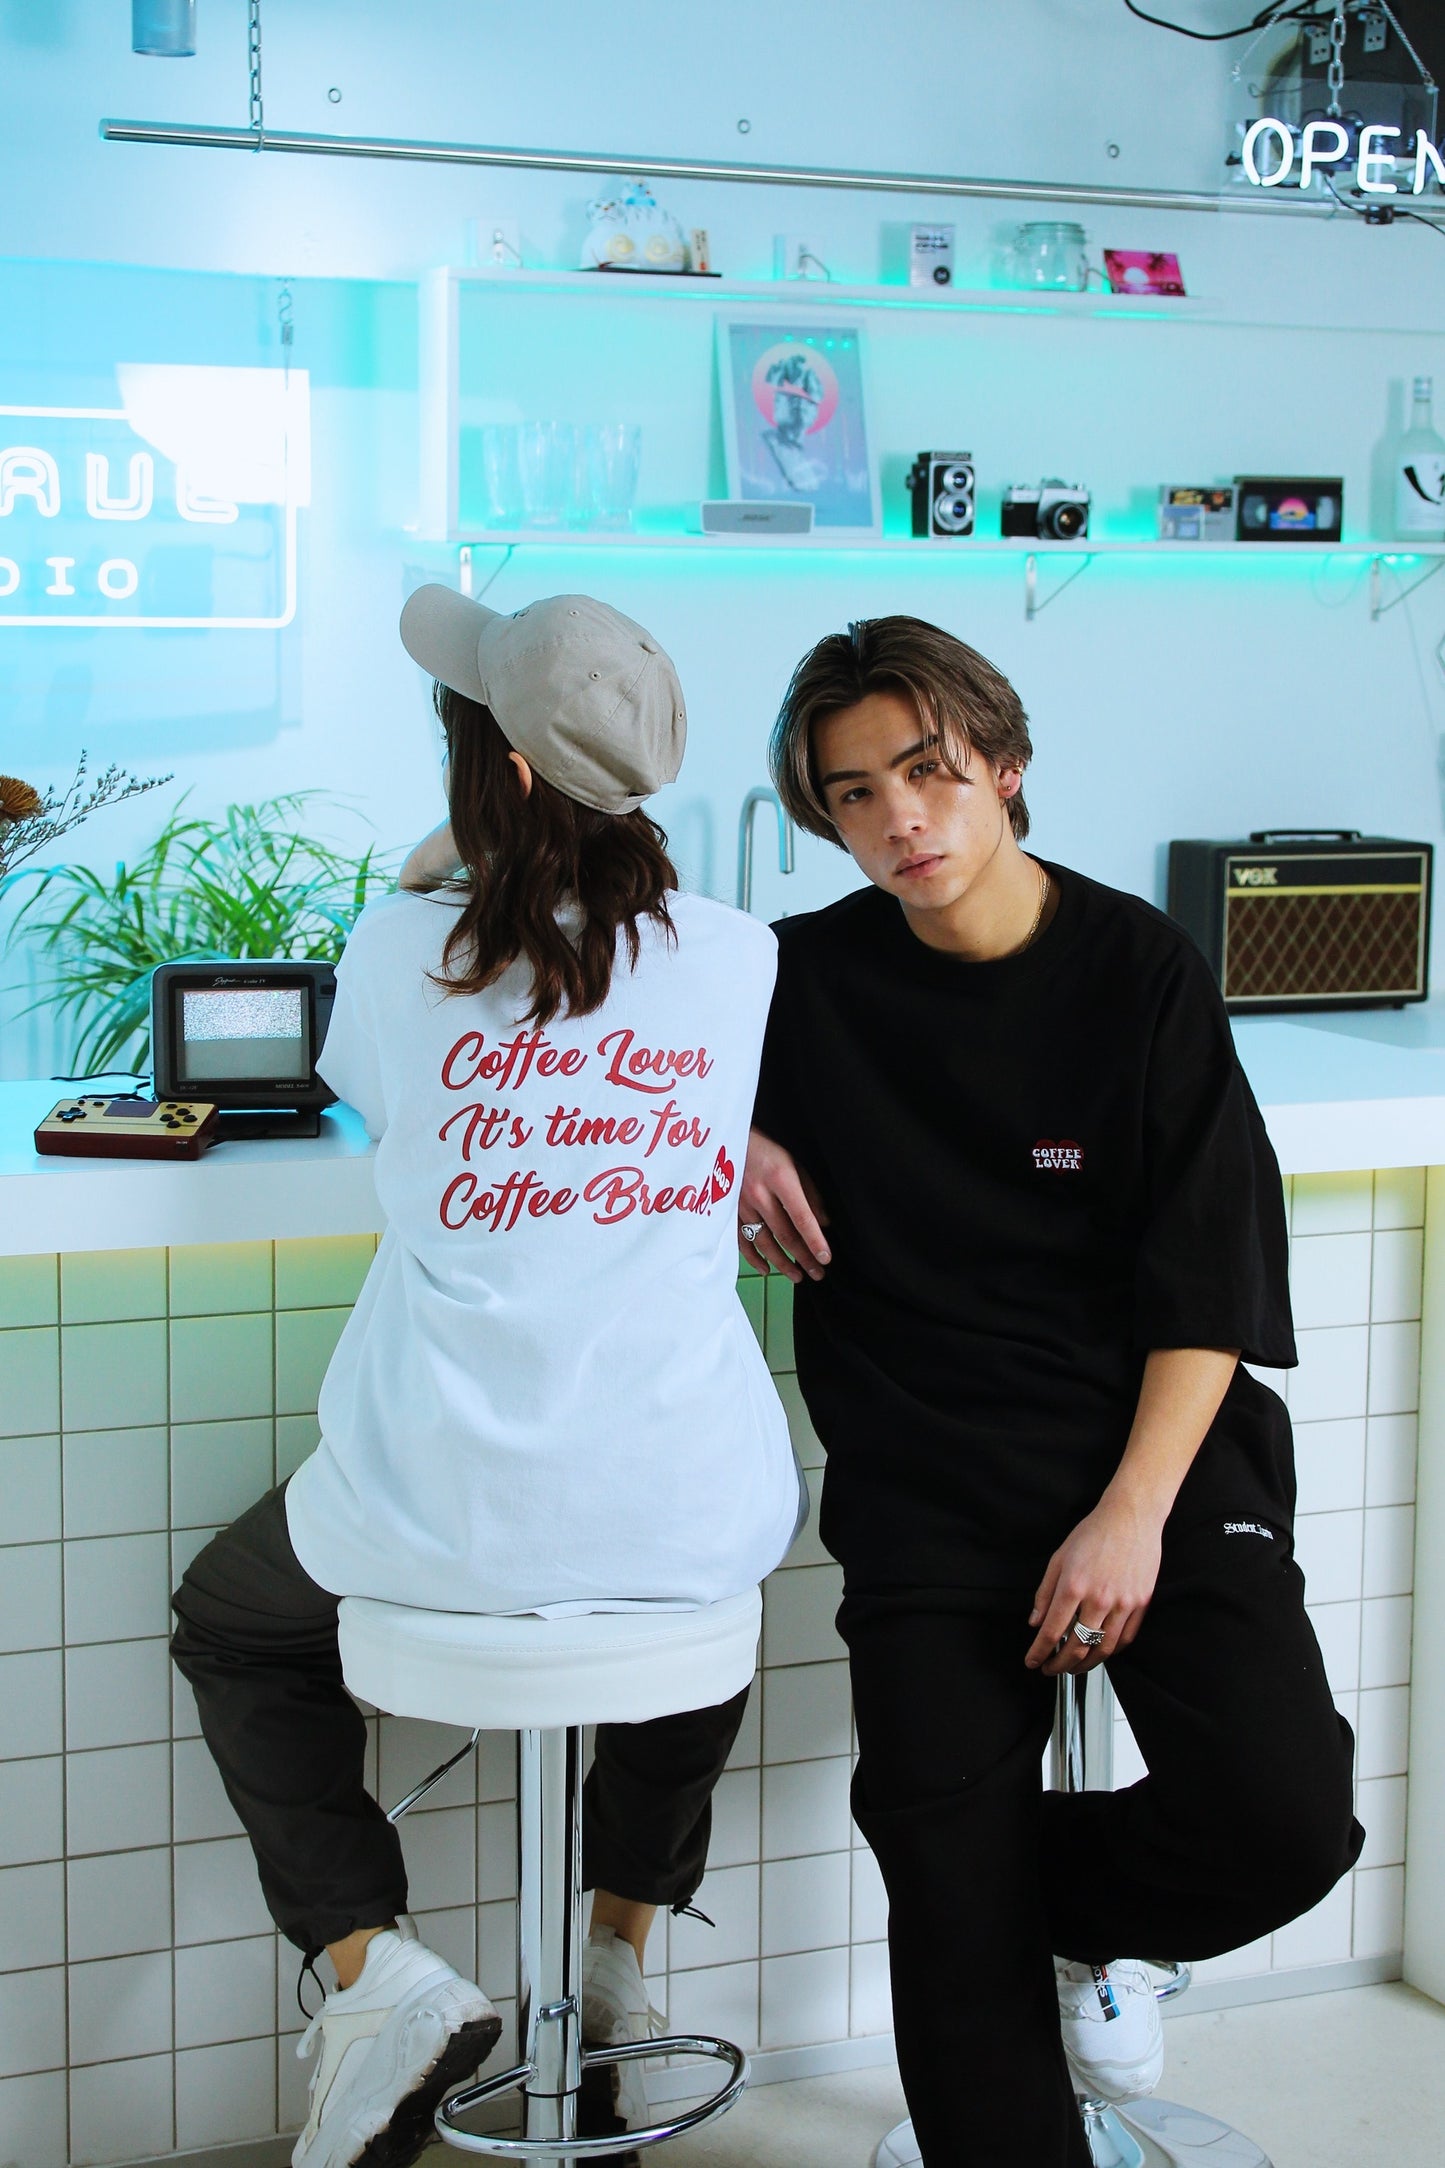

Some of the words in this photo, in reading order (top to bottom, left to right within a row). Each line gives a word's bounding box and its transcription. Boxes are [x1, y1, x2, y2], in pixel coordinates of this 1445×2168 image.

[1242, 117, 1445, 195] OPEN
[1233, 867, 1278, 886] VOX
[441, 1030, 588, 1091] Coffee
[597, 1029, 714, 1094] Lover
[438, 1102, 534, 1161] It's
[545, 1105, 645, 1147] time
[644, 1099, 711, 1158] for
[1032, 1148, 1082, 1159] COFFEE
[1035, 1158, 1080, 1169] LOVER
[439, 1170, 579, 1233] Coffee
